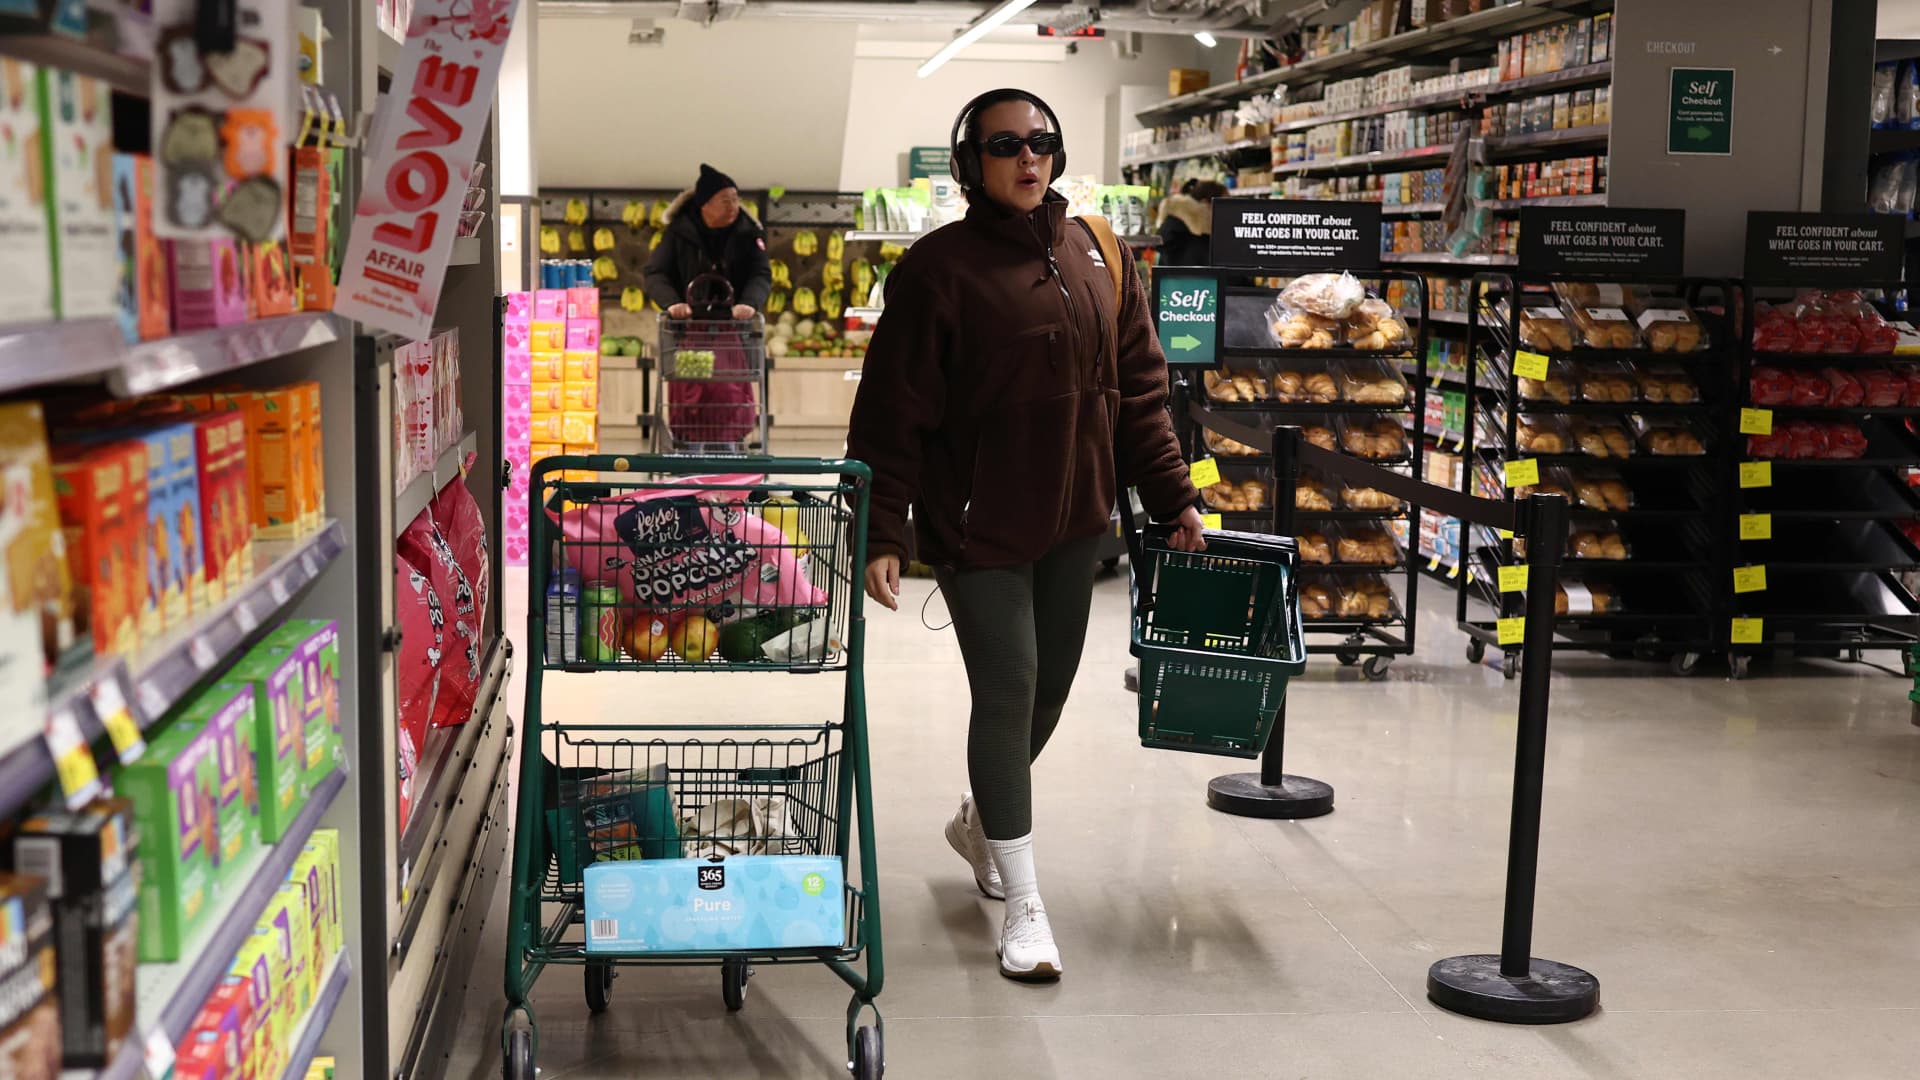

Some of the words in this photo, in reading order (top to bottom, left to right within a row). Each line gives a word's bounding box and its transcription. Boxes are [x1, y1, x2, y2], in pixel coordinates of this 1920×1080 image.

[1647, 41, 1696, 54] CHECKOUT
[1688, 80, 1719, 98] Self
[1681, 96, 1722, 106] Checkout
[372, 54, 480, 254] LOVE
[1242, 213, 1266, 225] FEEL
[1267, 213, 1321, 225] CONFIDENT
[1322, 215, 1352, 226] about
[1234, 227, 1264, 238] WHAT
[1265, 227, 1291, 239] GOES
[1292, 228, 1302, 239] IN
[1304, 228, 1330, 240] YOUR
[1331, 229, 1359, 240] CART.
[1551, 221, 1574, 232] FEEL
[1575, 221, 1627, 233] CONFIDENT
[1628, 224, 1656, 234] about
[1776, 226, 1799, 237] FEEL
[1800, 226, 1849, 238] CONFIDENT
[1850, 228, 1878, 238] about
[1543, 234, 1571, 245] WHAT
[1573, 235, 1597, 246] GOES
[1599, 235, 1609, 246] IN
[1611, 236, 1636, 247] YOUR
[1637, 236, 1664, 248] CART.
[1769, 239, 1796, 250] WHAT
[1797, 240, 1821, 251] GOES
[1822, 240, 1832, 251] IN
[1834, 240, 1858, 251] YOUR
[1859, 241, 1885, 252] CART.
[366, 248, 425, 279] AFFAIR
[1169, 289, 1210, 311] Self
[1159, 310, 1216, 322] Checkout
[634, 545, 757, 602] POPCORN
[700, 869, 722, 882] 365
[807, 876, 820, 888] 12
[693, 898, 731, 913] Pure
